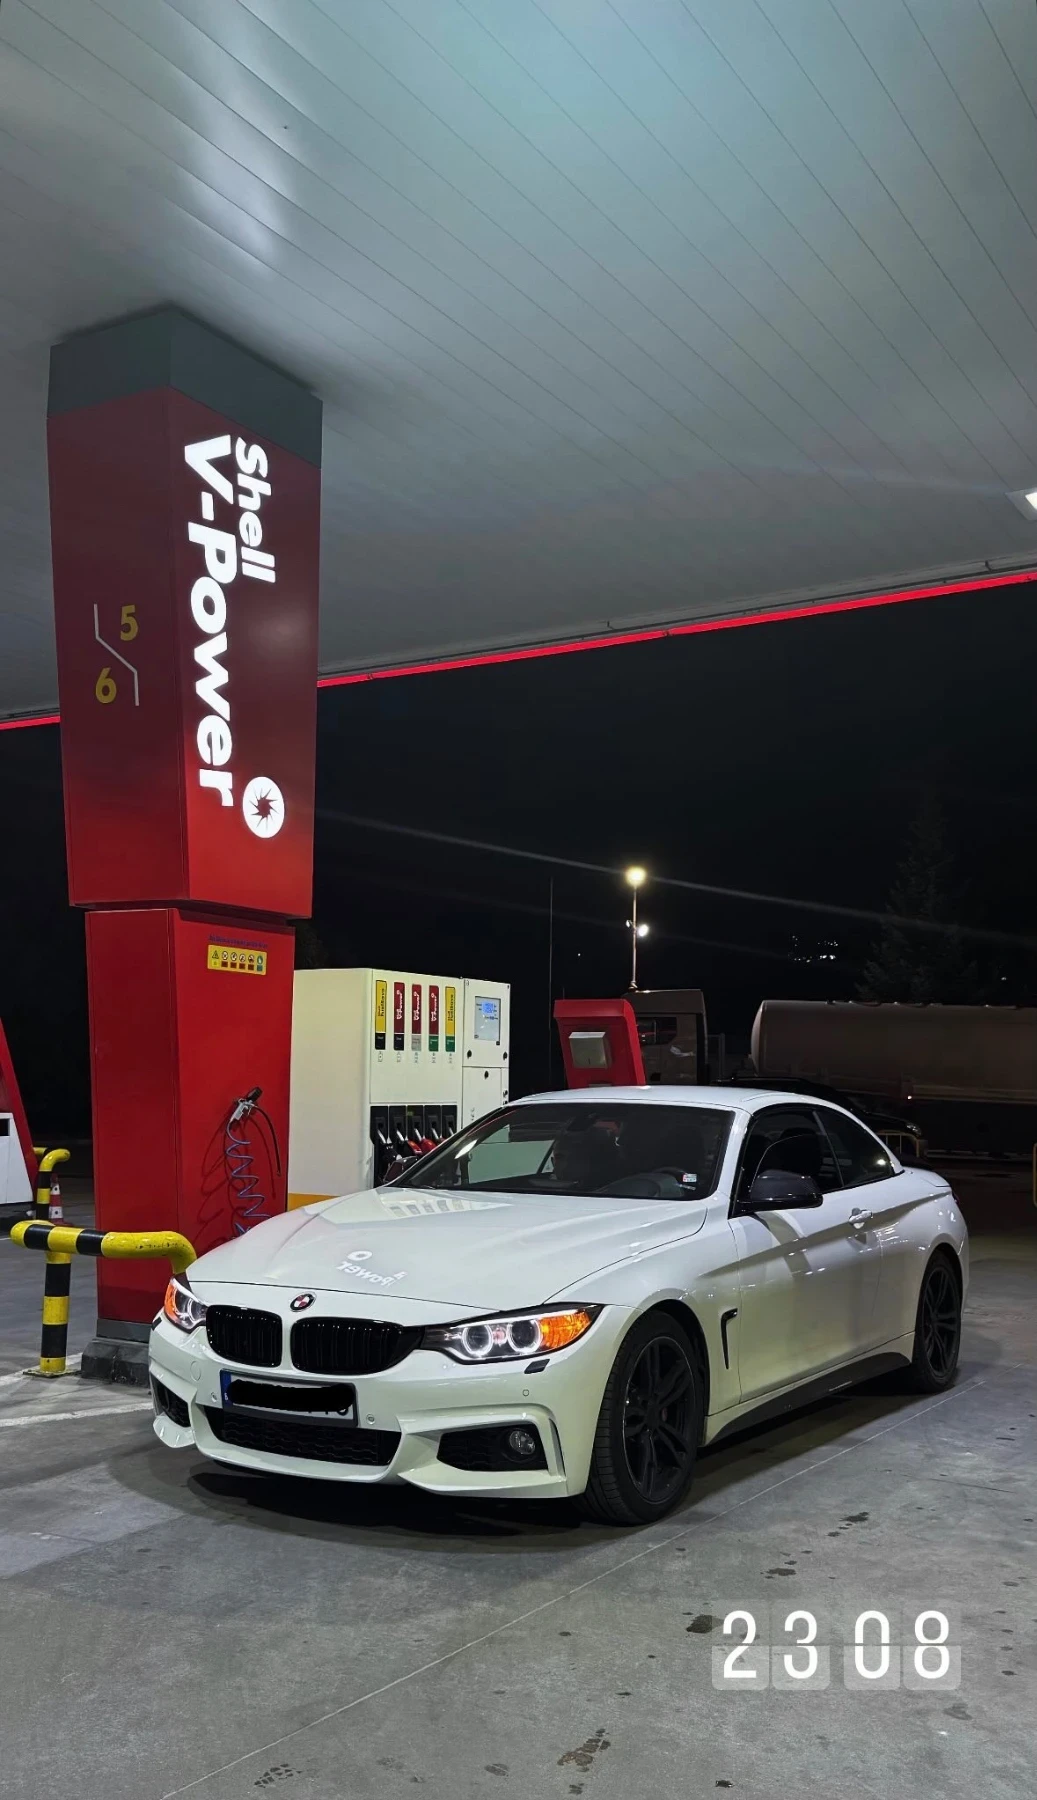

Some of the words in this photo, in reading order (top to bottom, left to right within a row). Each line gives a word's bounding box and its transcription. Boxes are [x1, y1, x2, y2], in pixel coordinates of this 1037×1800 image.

[236, 437, 276, 583] Shell
[119, 605, 139, 641] 5
[184, 434, 238, 808] V-Power
[95, 667, 117, 704] 6
